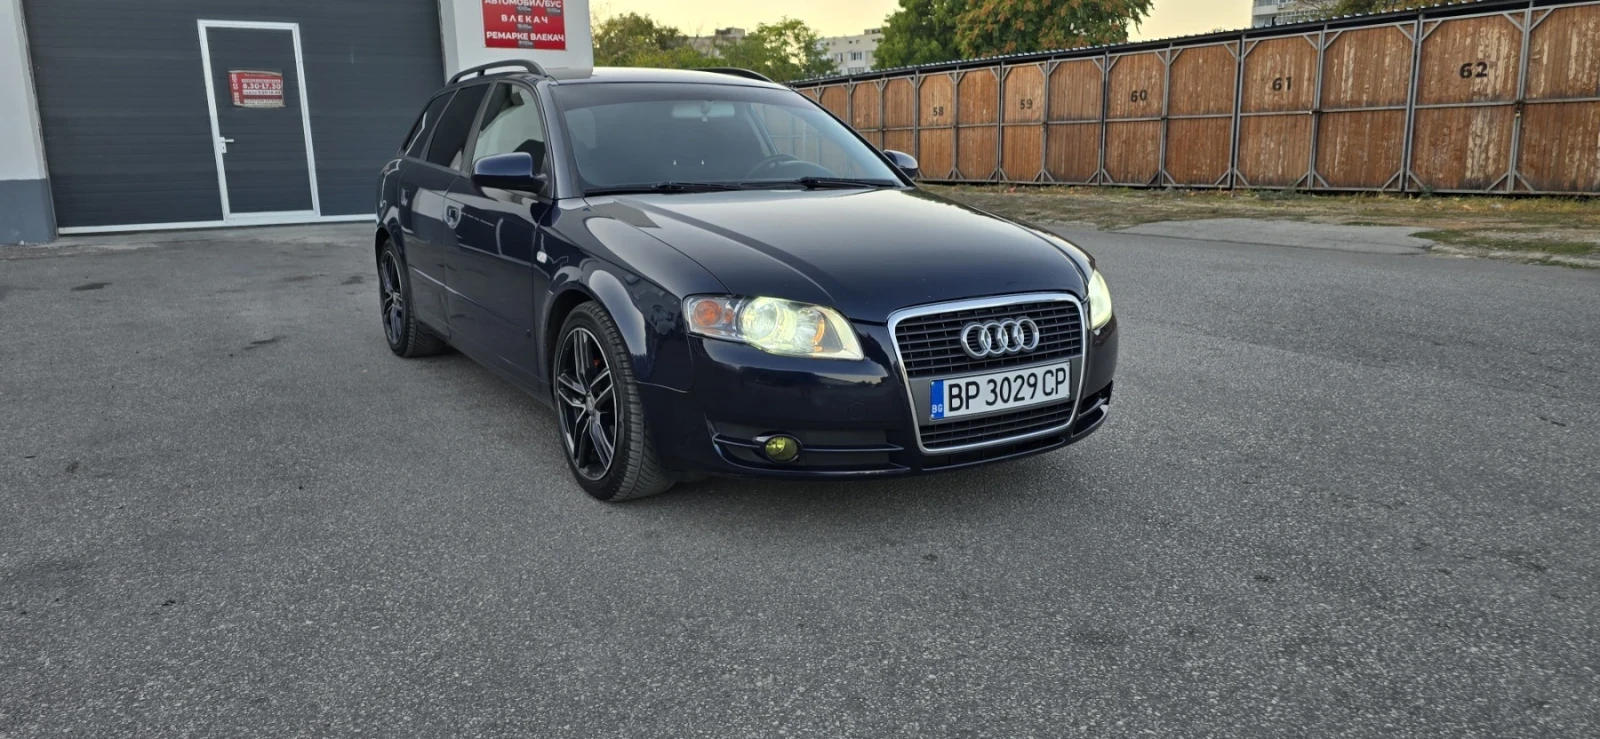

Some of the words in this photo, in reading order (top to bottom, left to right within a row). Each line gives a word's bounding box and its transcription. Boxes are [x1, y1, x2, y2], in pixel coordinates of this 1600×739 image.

[501, 14, 549, 24] ВЛЕКАЧ
[486, 31, 529, 40] РЕМАРКЕ
[530, 33, 565, 41] ВЛЕКАЧ
[1459, 61, 1488, 79] 62
[1272, 76, 1292, 91] 61
[1131, 89, 1147, 103] 60
[1020, 99, 1033, 110] 59
[932, 106, 944, 117] 58
[948, 381, 980, 412] BP
[985, 372, 1038, 406] 3029
[1042, 367, 1067, 397] CP
[931, 404, 943, 414] BG
